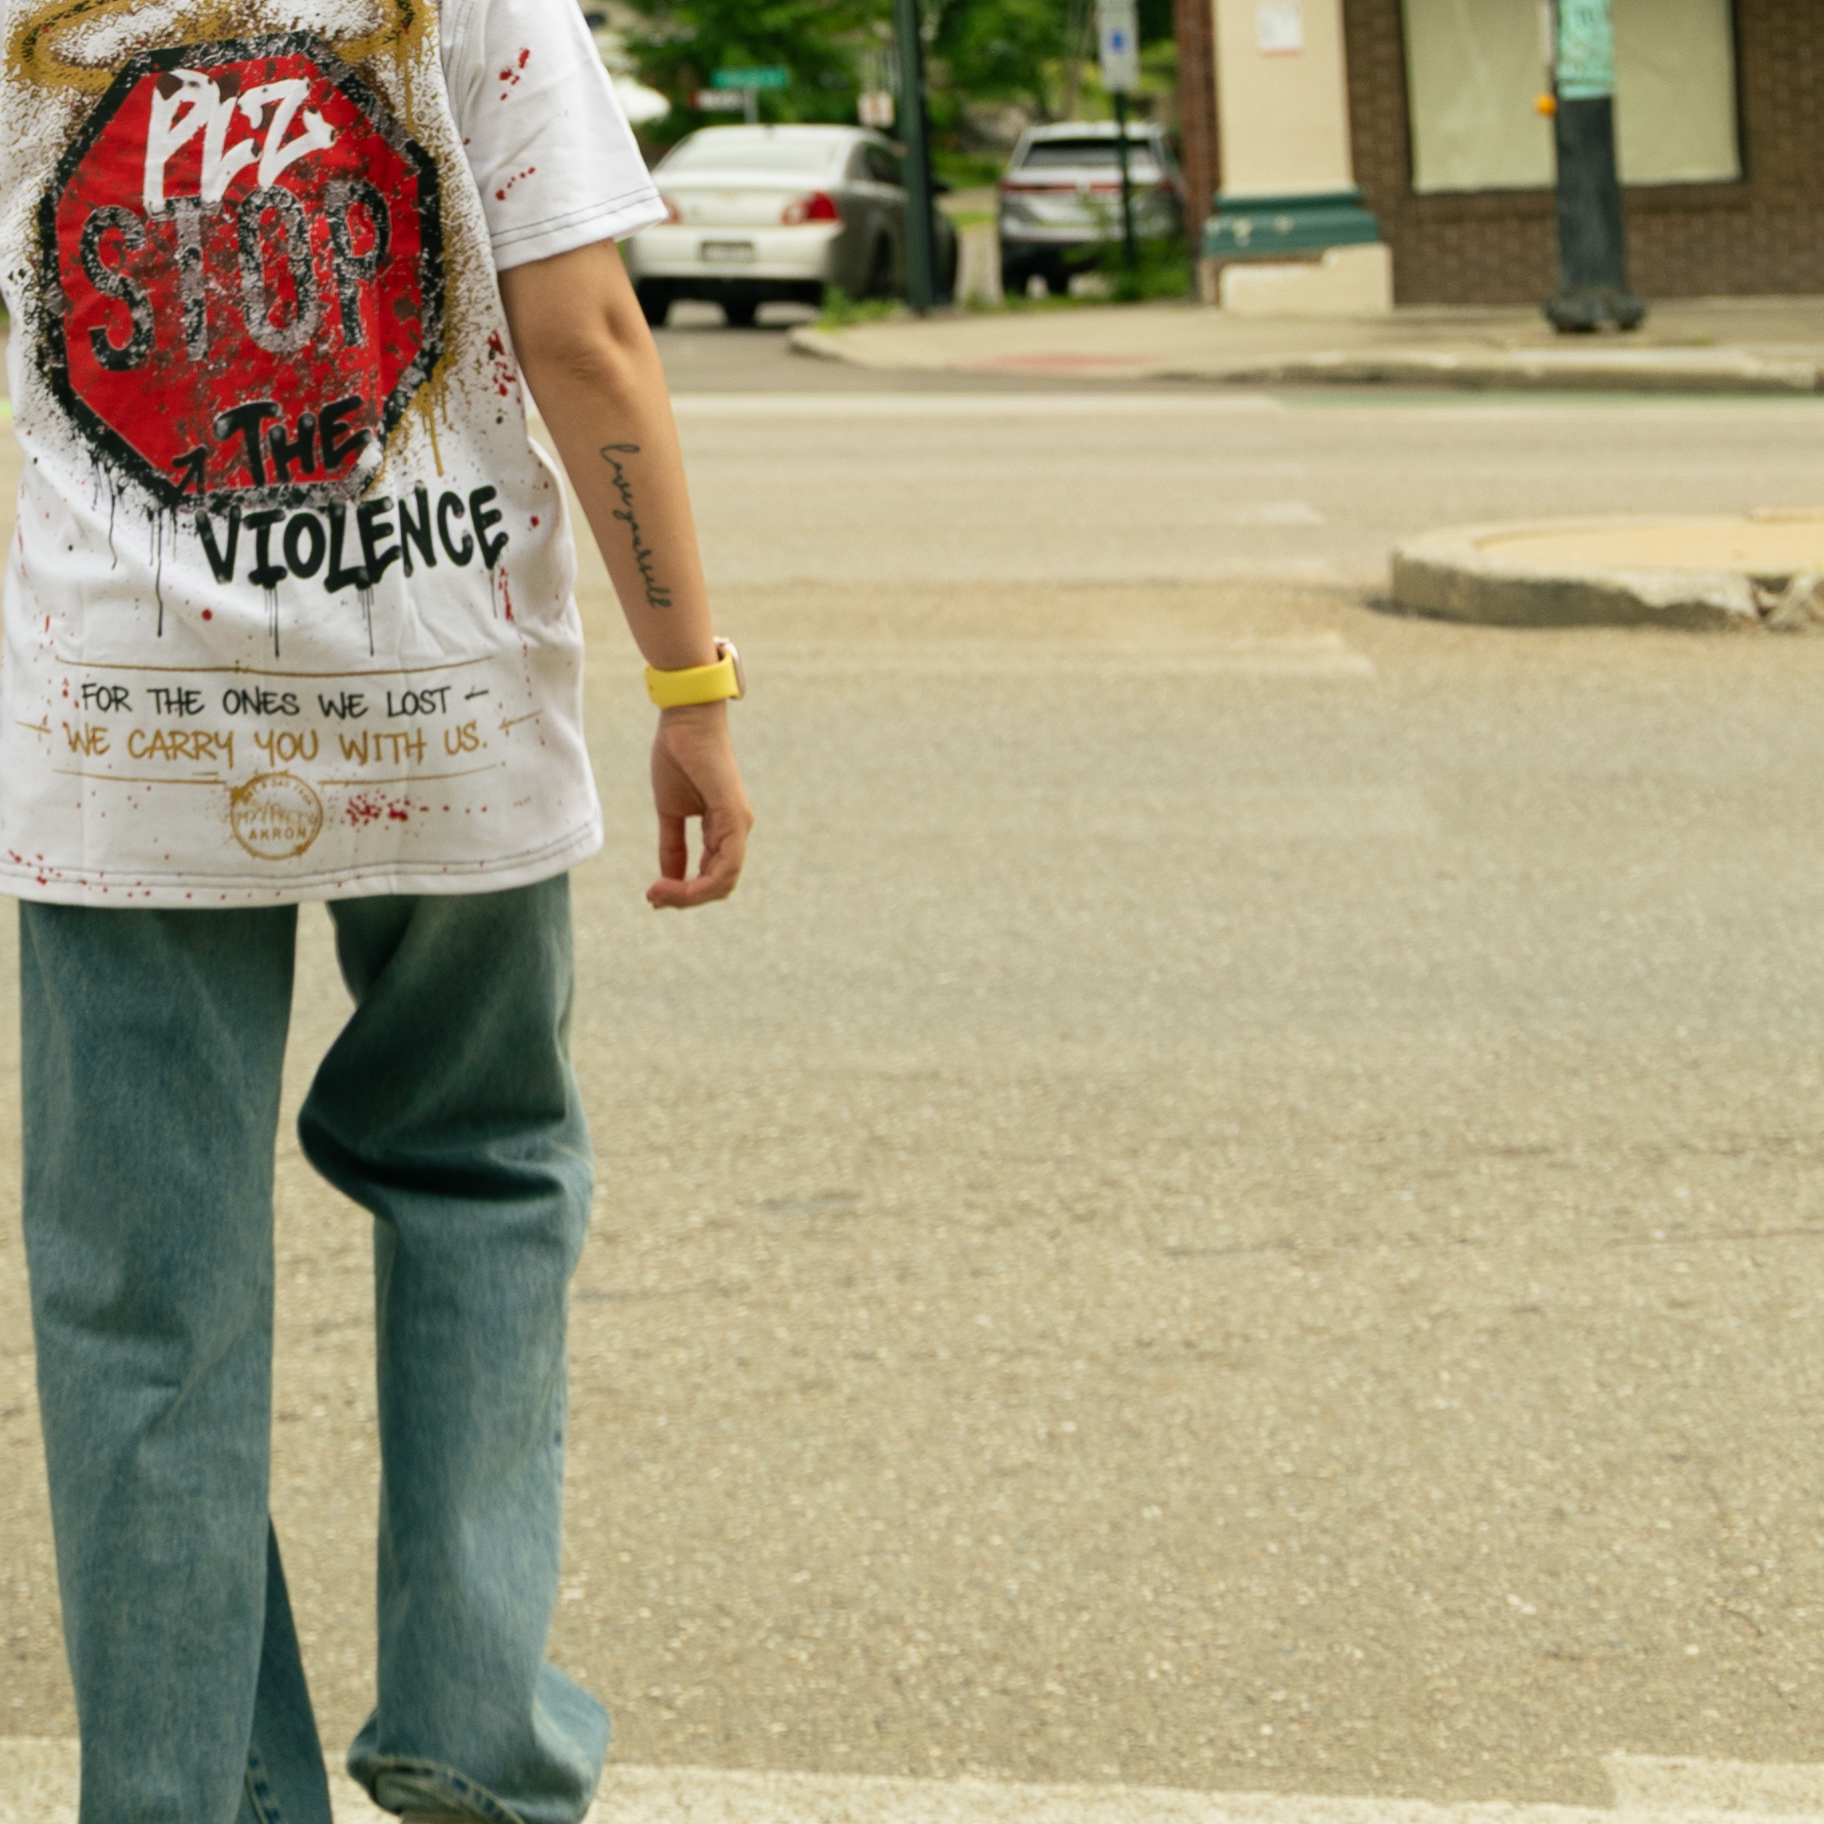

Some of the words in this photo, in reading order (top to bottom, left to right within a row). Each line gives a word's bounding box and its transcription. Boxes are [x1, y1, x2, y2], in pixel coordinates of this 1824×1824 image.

[143, 69, 337, 214] PLZ
[80, 179, 392, 373] STOP
[214, 395, 371, 488] THE
[195, 481, 509, 593] VIOLENCE
[63, 722, 111, 757] WE
[127, 728, 234, 769] CARRY
[254, 728, 319, 764] YOU
[339, 728, 428, 767] WITH
[444, 723, 488, 756] US.
[81, 683, 133, 713] FOR
[147, 687, 205, 718] THE
[222, 687, 300, 717] ONES
[317, 691, 369, 719] WE
[386, 686, 452, 717] LOST
[248, 827, 307, 840] AKRON
